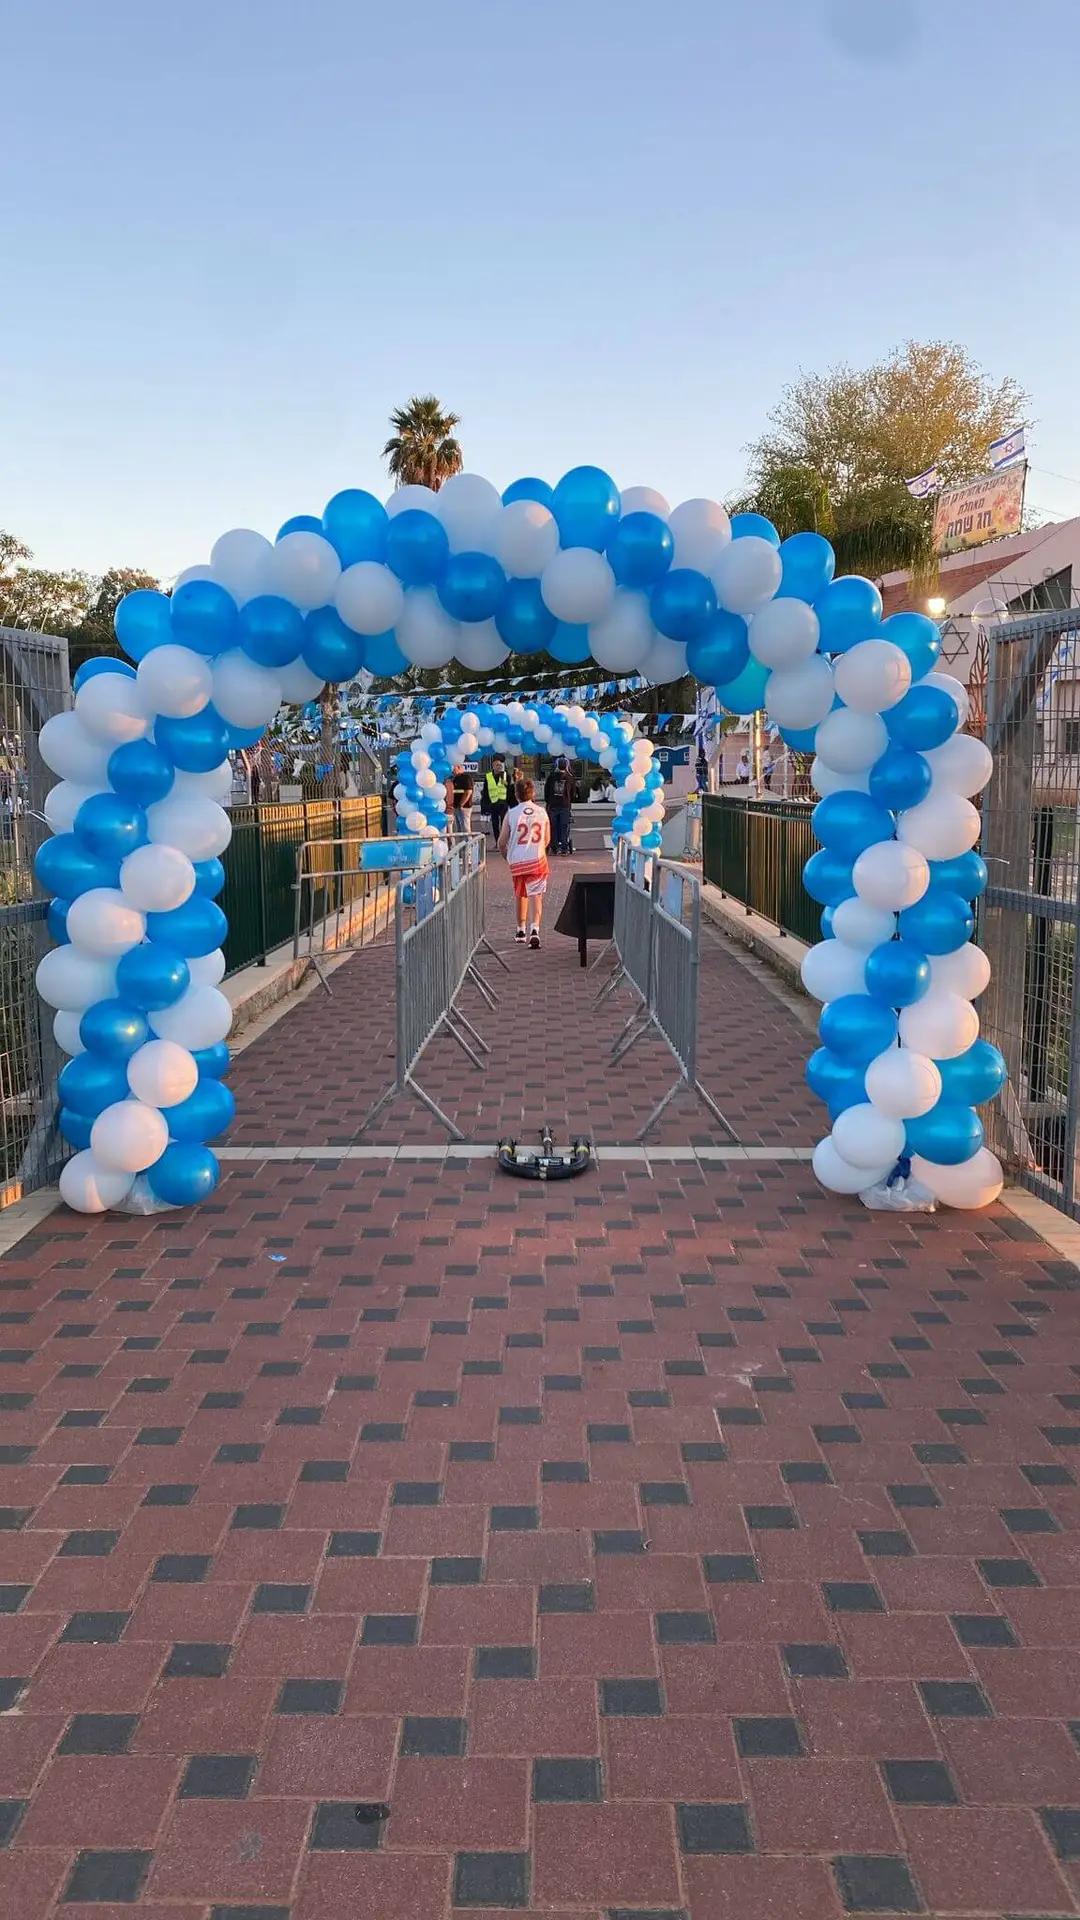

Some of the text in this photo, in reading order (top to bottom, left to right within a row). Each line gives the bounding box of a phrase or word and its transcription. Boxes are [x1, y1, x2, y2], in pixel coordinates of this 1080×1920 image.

[958, 498, 985, 515] מאחלת
[946, 510, 992, 539] חג שמח
[517, 822, 542, 845] 23
